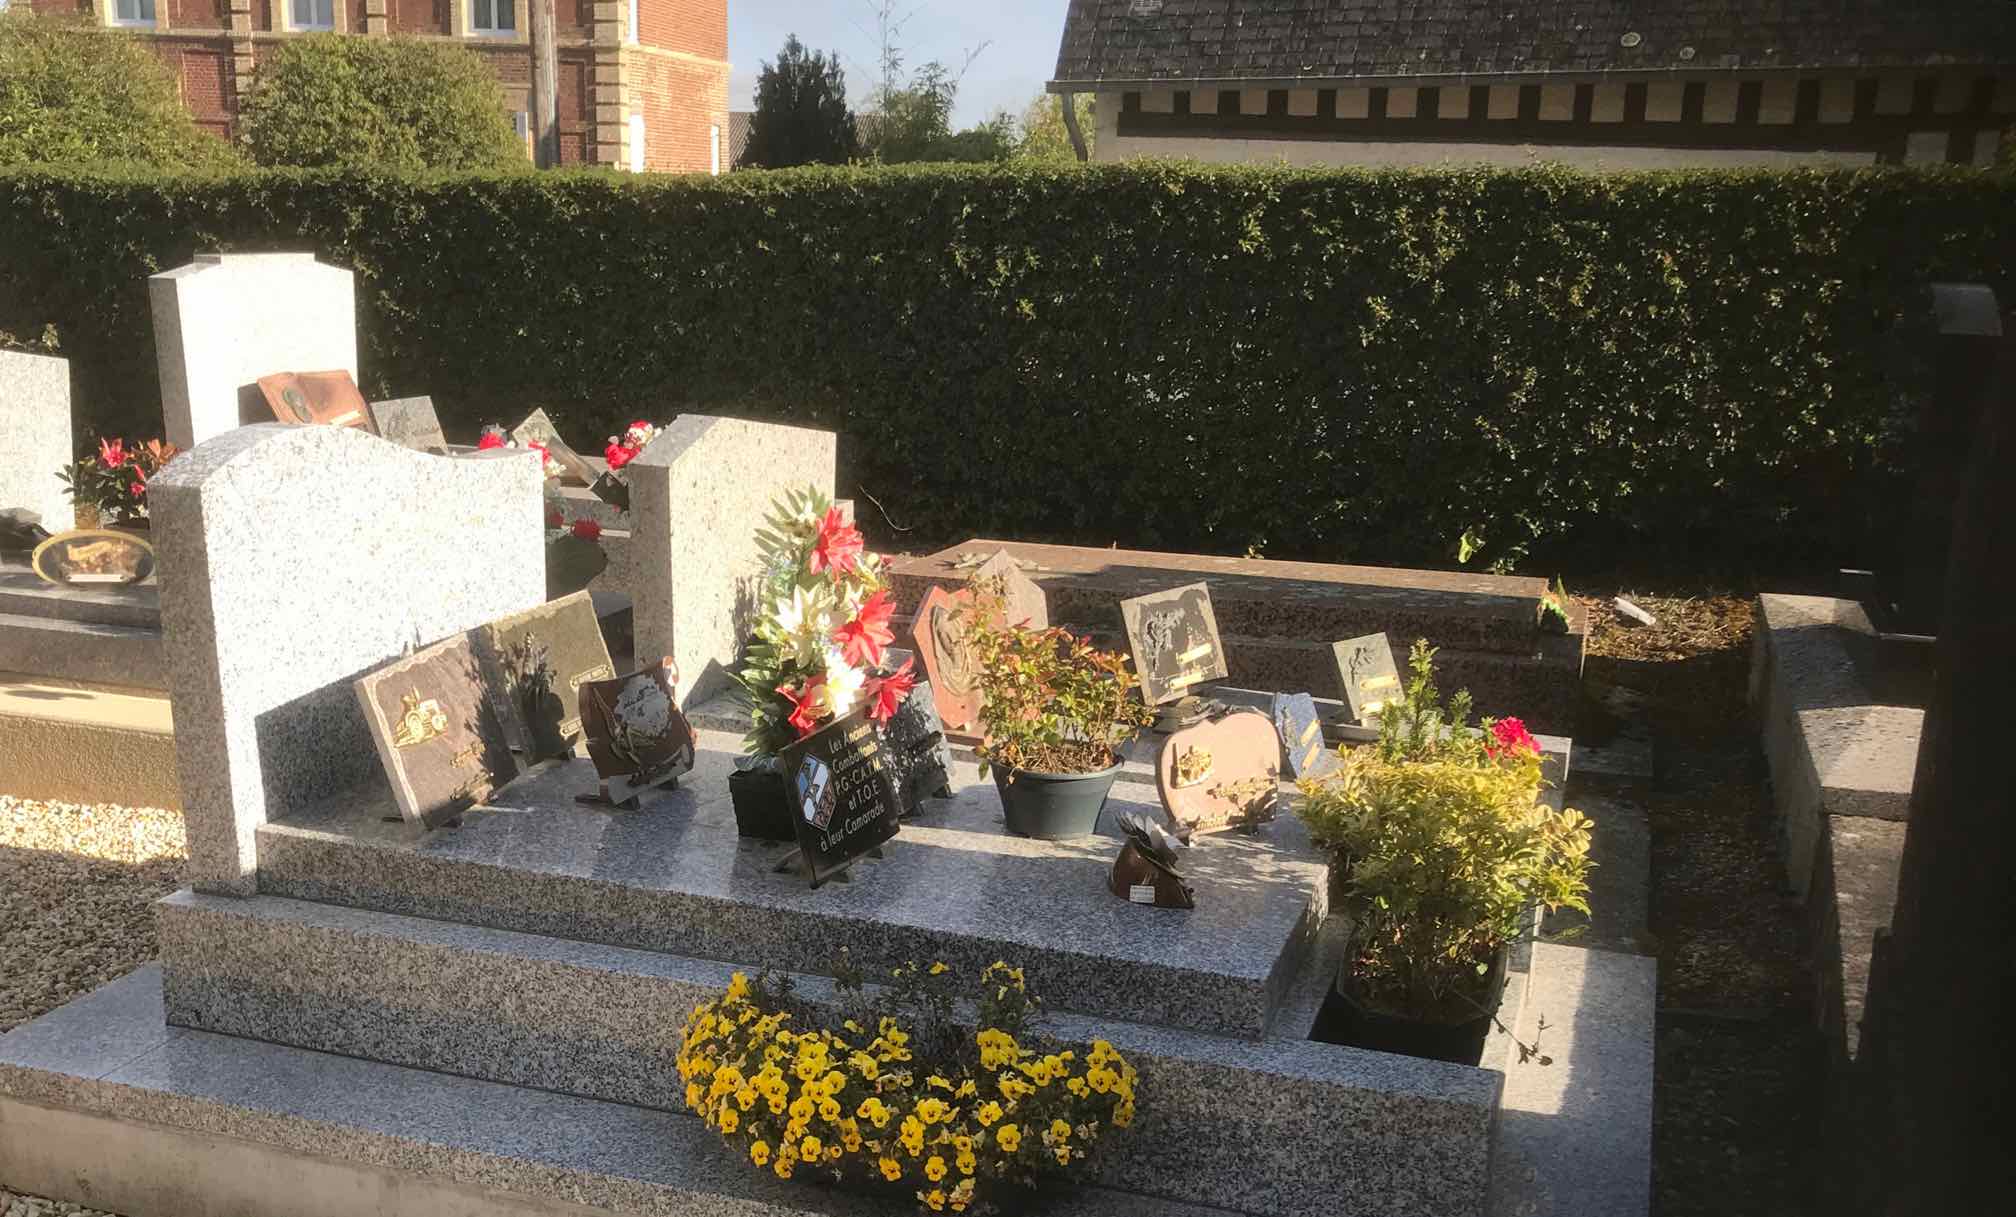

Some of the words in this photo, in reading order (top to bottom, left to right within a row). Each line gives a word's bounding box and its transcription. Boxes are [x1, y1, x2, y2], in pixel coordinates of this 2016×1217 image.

[828, 738, 842, 754] Les
[832, 741, 878, 774] Combattants
[848, 796, 857, 810] et
[820, 837, 828, 852] à
[827, 829, 844, 847] leur
[845, 800, 885, 834] Camarade
